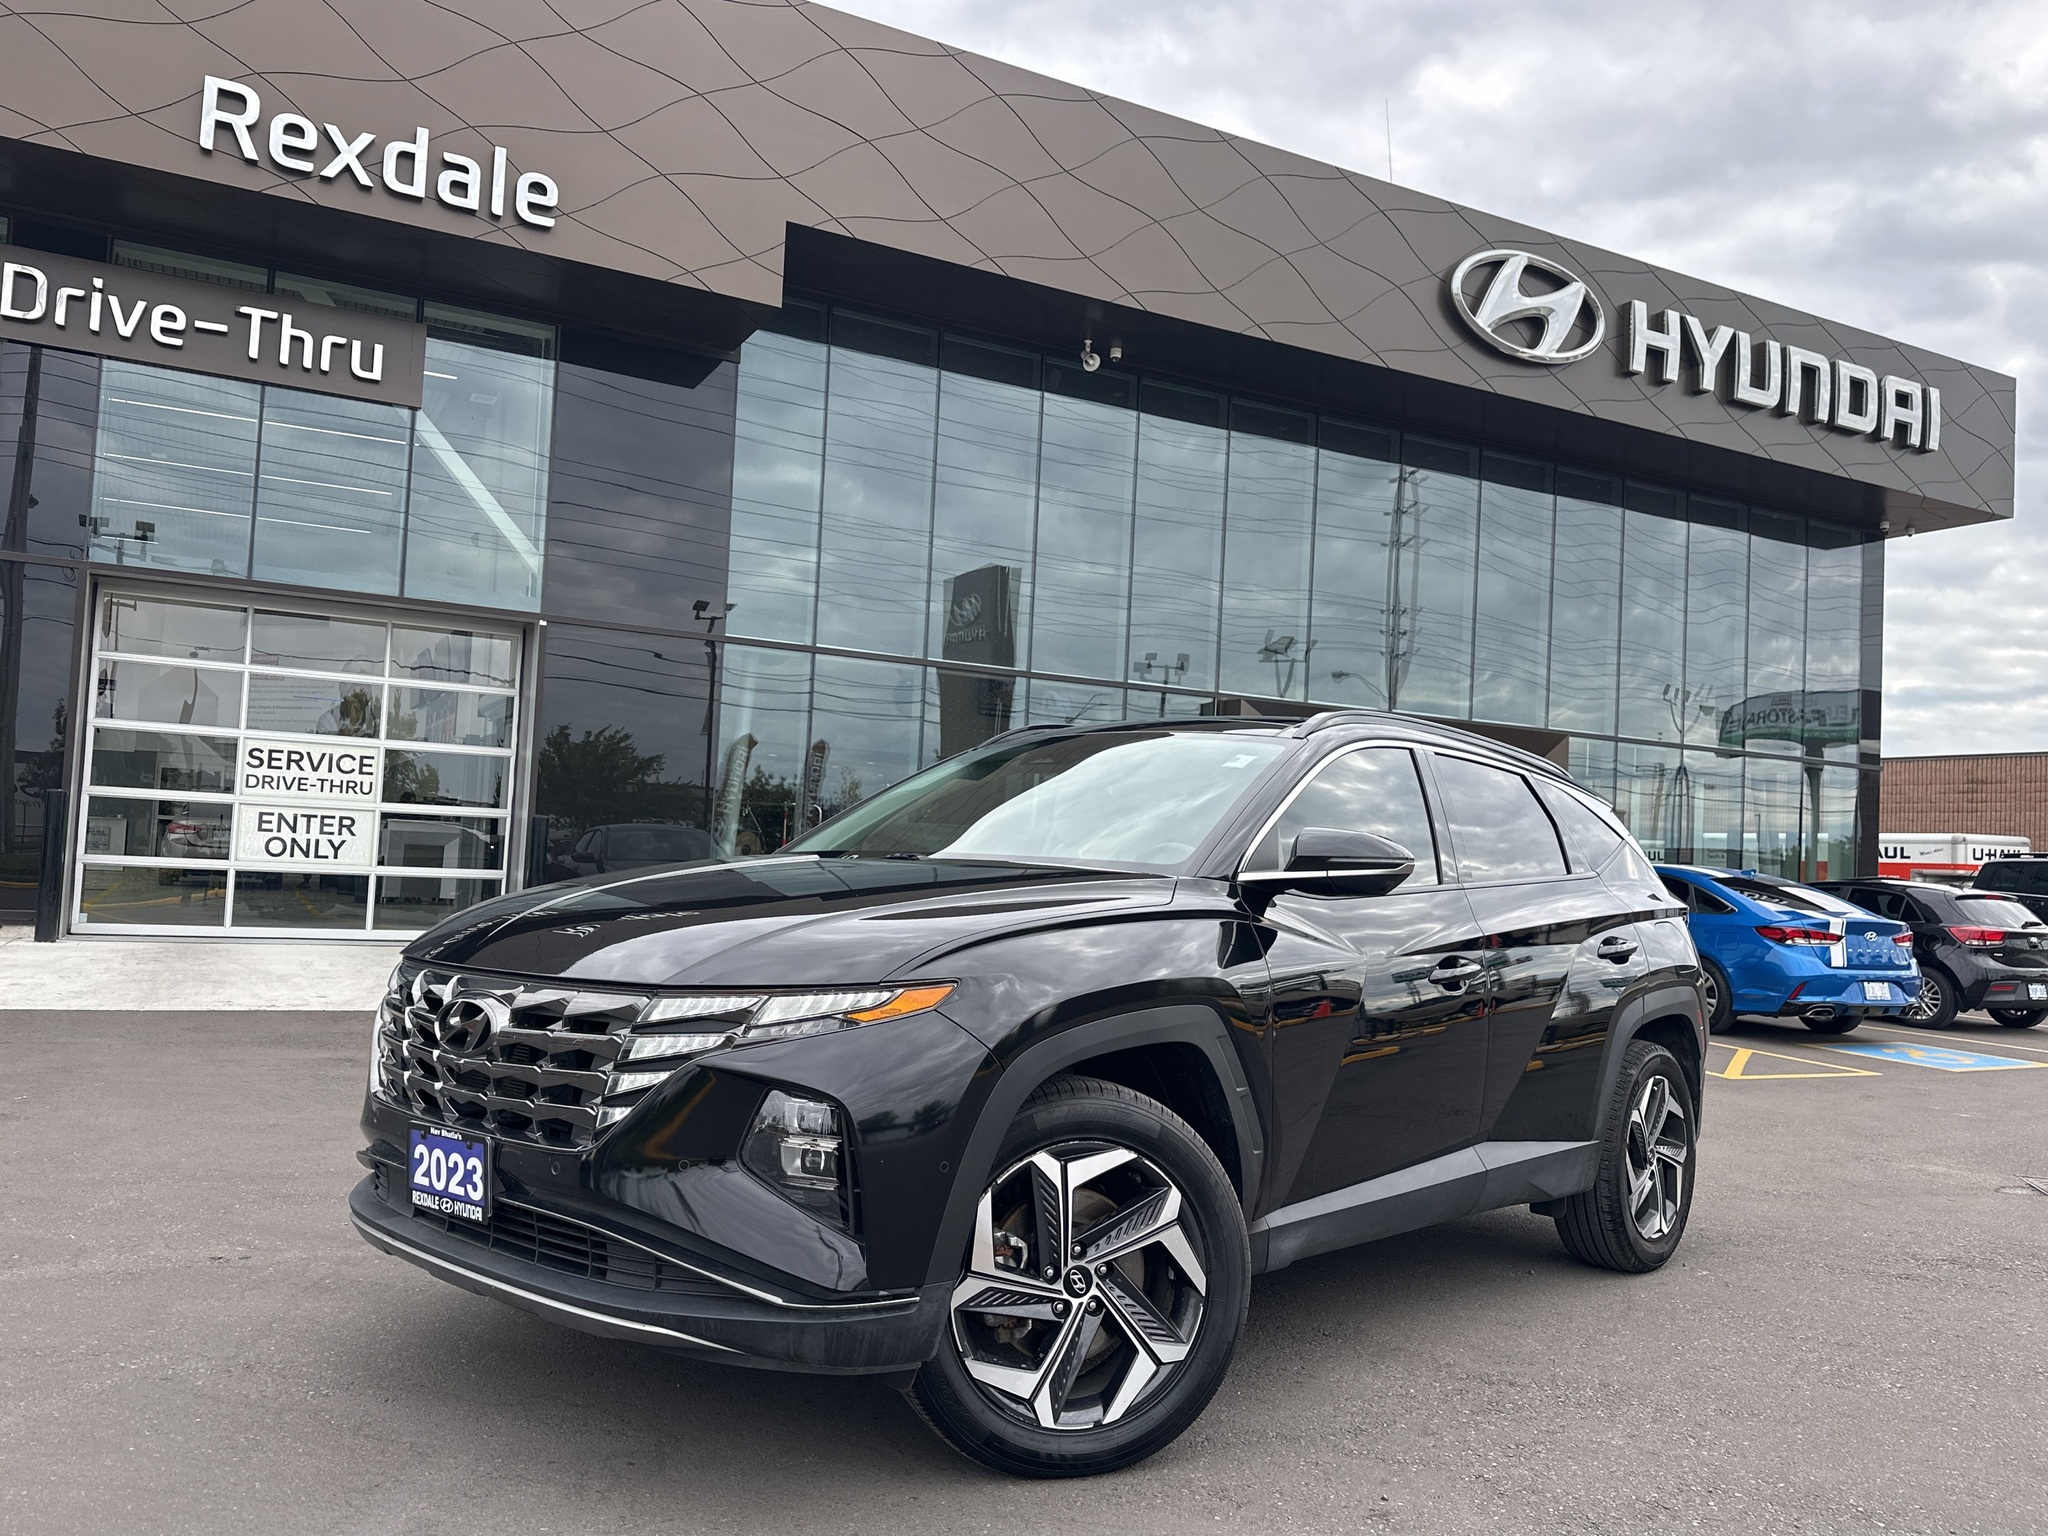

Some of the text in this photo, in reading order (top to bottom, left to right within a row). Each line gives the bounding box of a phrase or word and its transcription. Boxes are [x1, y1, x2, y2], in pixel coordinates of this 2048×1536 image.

[199, 74, 559, 229] Rexdale
[0, 261, 385, 382] Drive-Thru
[1627, 298, 1941, 453] HYUNDAI
[246, 747, 375, 776] SERVICE
[245, 773, 373, 795] DRIVE-THRU
[257, 811, 356, 837] ENTER
[264, 836, 347, 860] ONLY
[413, 1143, 484, 1201] 2023
[412, 1190, 483, 1221] REXDALE HYUNDAI
